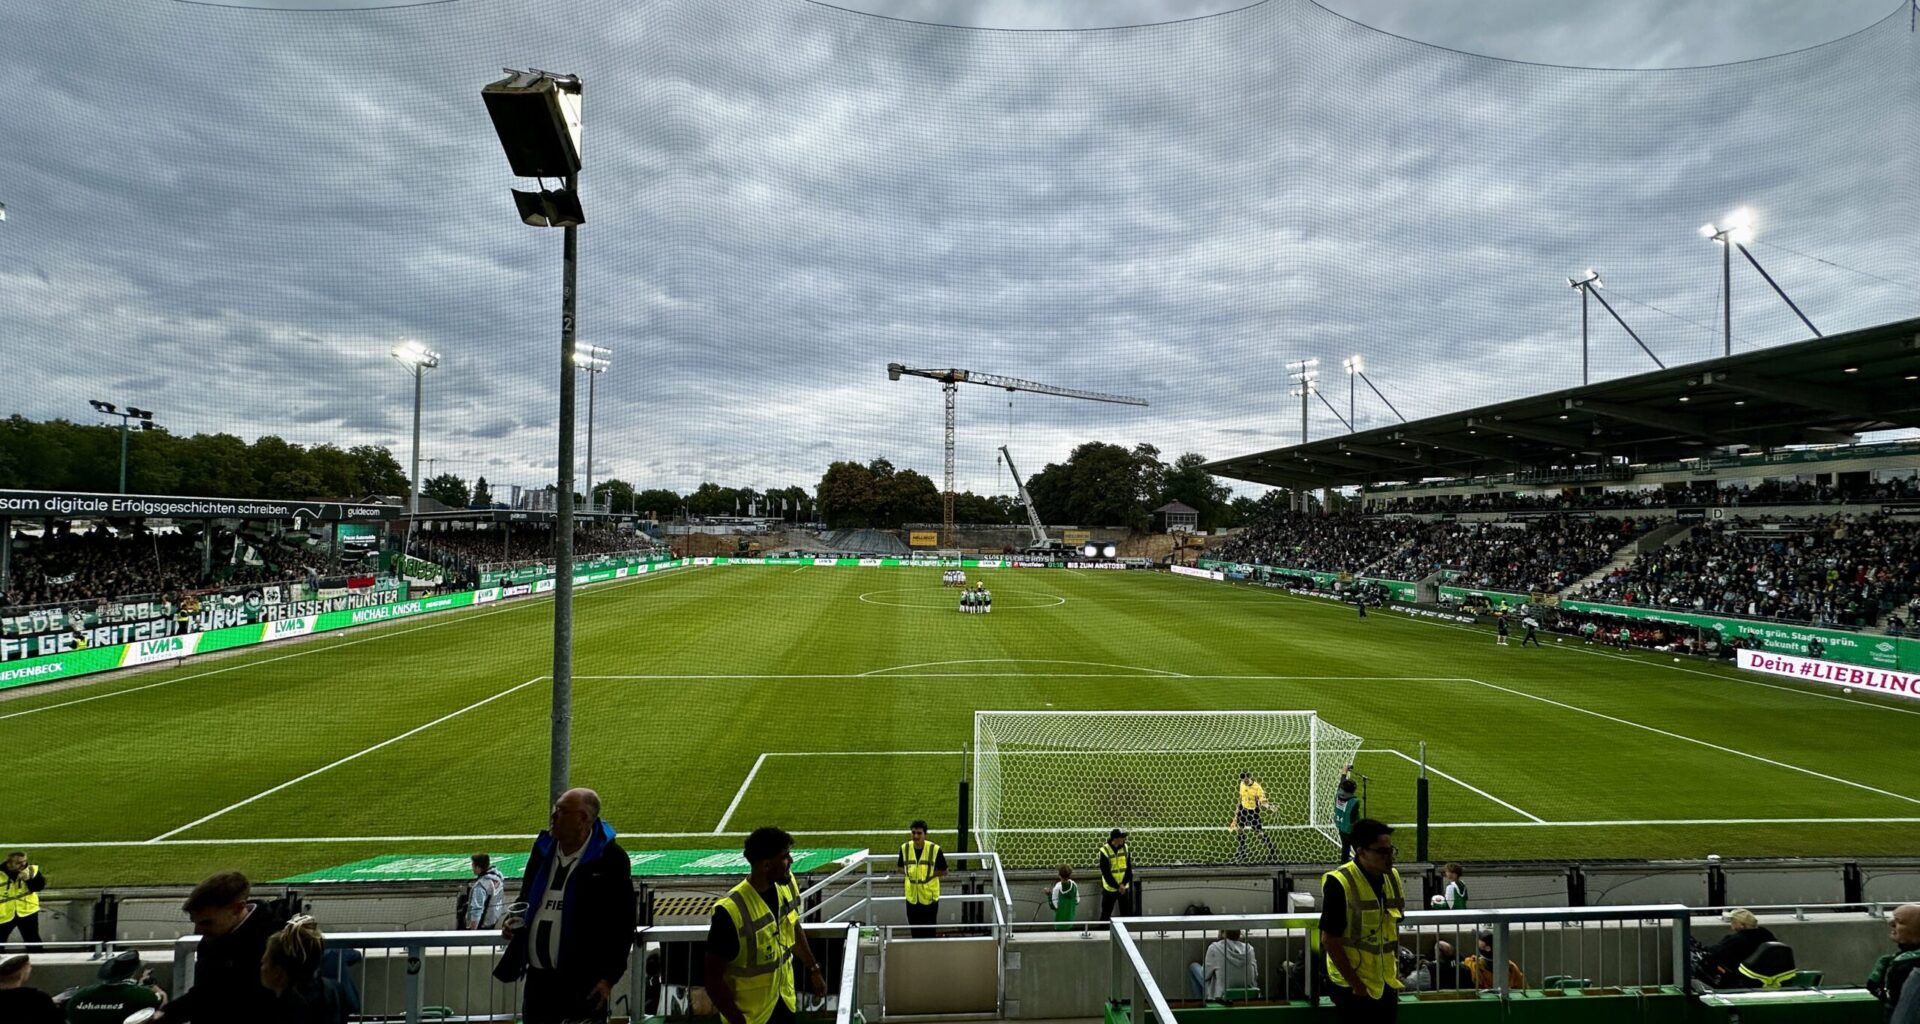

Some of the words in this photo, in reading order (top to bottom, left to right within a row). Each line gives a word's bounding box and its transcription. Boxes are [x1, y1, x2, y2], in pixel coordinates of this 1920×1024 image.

[564, 317, 573, 331] 2
[0, 498, 39, 510] sam
[44, 497, 108, 514] digitale
[112, 499, 235, 515] Erfolgsgeschichten
[238, 503, 290, 515] schreiben.
[348, 508, 381, 518] guidecom
[1714, 509, 1723, 518] D
[259, 598, 332, 623] PREUSSEN
[348, 590, 398, 610] MÜNSTER
[352, 608, 390, 623] MICHAEL
[392, 602, 422, 616] KNISPEL
[275, 619, 297, 634] LVM
[1738, 625, 1764, 636] Trikot
[1765, 629, 1790, 639] grün.
[1830, 636, 1858, 647] grün.
[1764, 639, 1799, 650] Zukunft
[140, 638, 171, 657] LVM
[0, 662, 63, 681] IEVENBECK
[1751, 654, 1795, 674] Dein
[76, 1001, 125, 1010] Johannes
